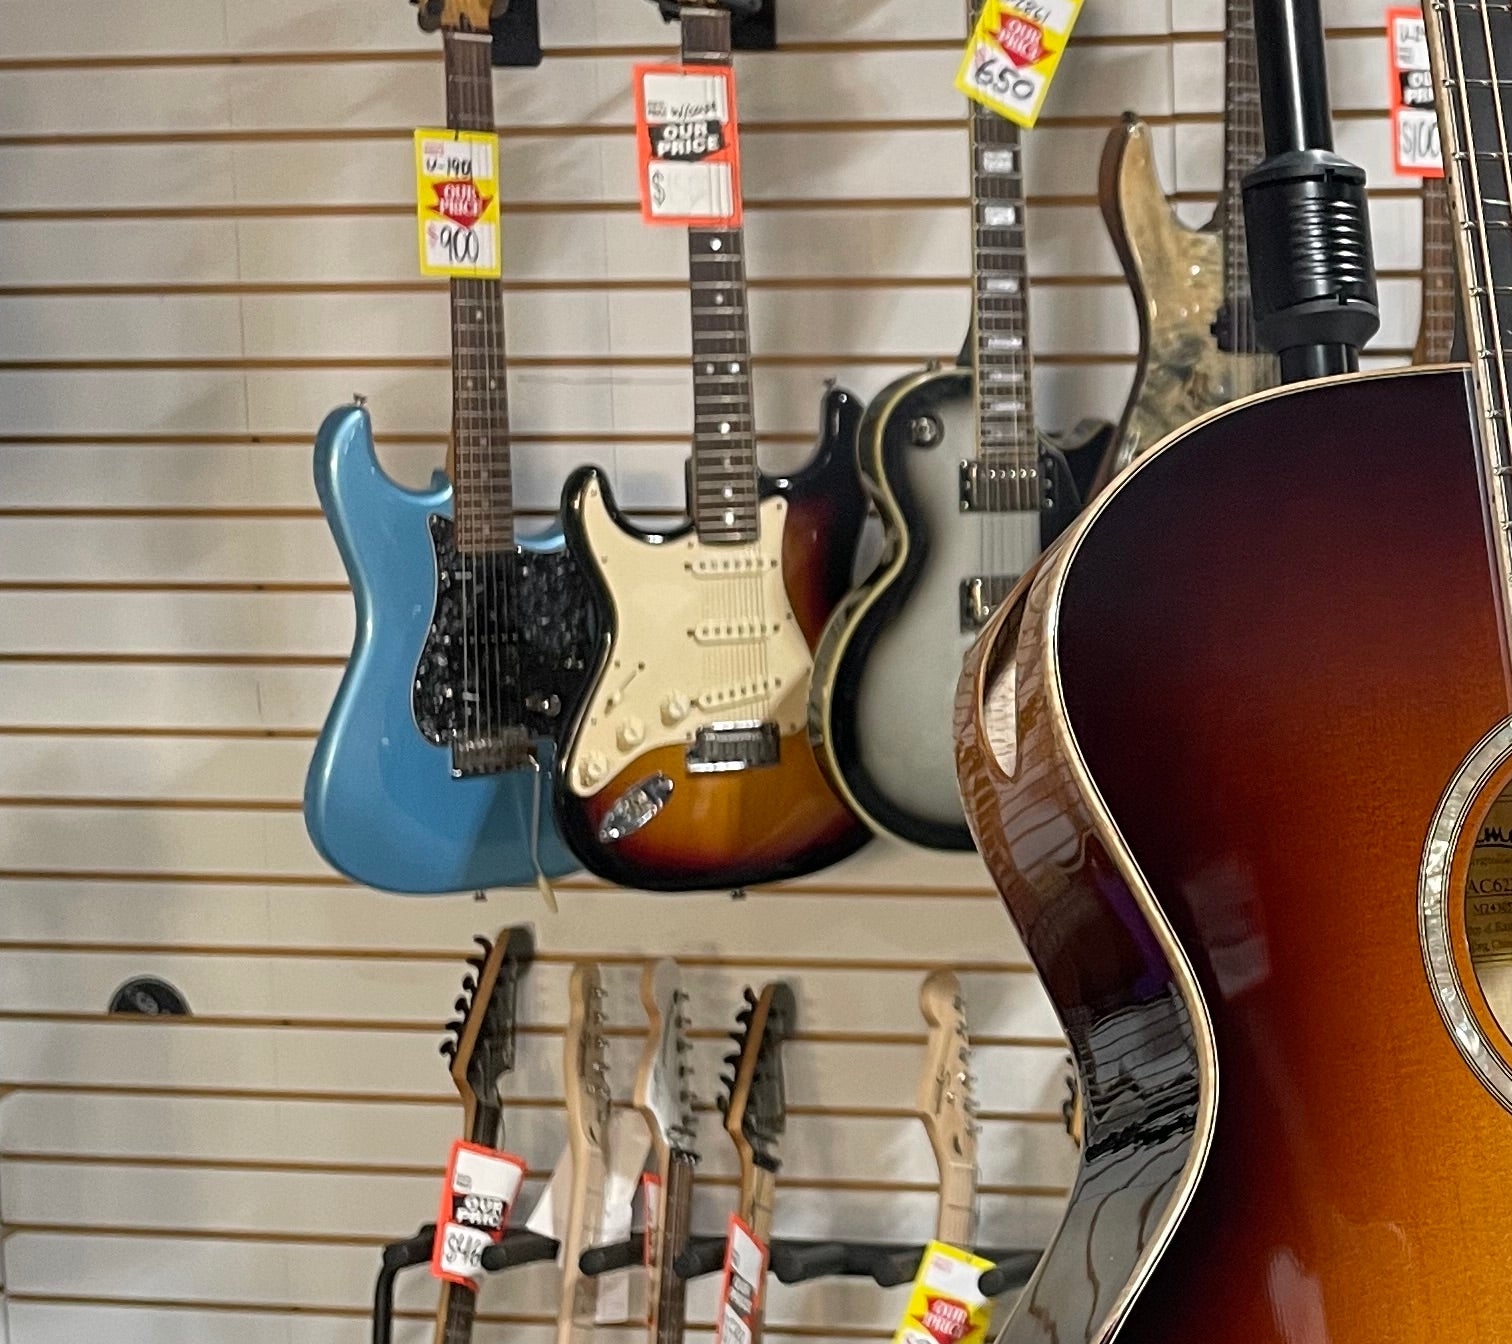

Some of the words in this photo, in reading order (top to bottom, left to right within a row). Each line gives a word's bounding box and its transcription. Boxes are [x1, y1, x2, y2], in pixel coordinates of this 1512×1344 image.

[1009, 17, 1043, 44] OUR
[1409, 71, 1433, 90] OU
[1404, 87, 1434, 106] PRI
[663, 122, 708, 141] OUR
[657, 134, 720, 158] PRICE
[443, 183, 478, 201] OUR
